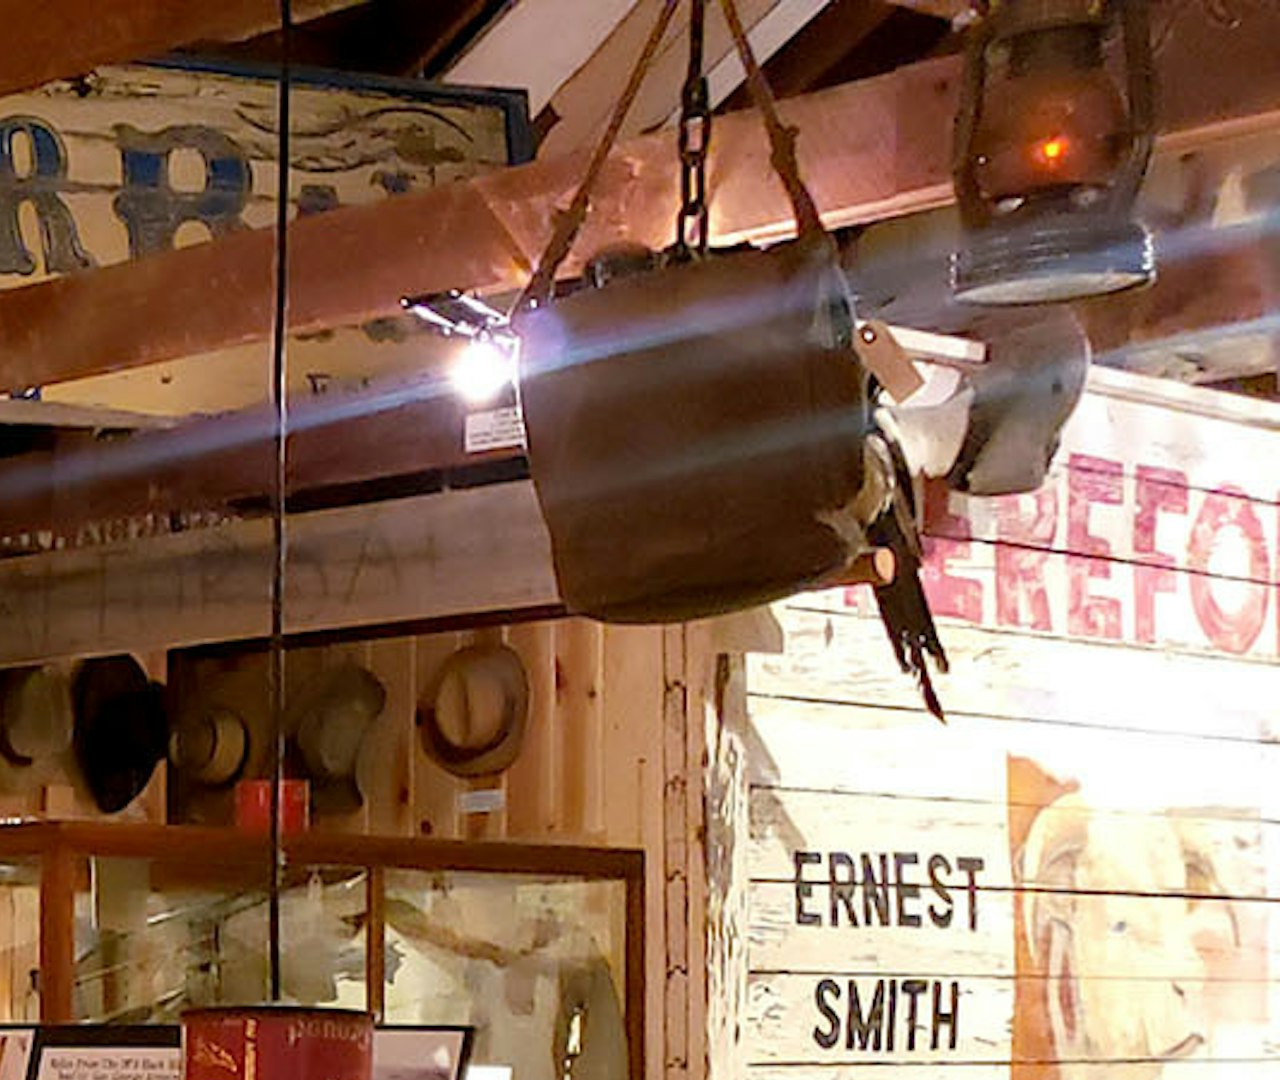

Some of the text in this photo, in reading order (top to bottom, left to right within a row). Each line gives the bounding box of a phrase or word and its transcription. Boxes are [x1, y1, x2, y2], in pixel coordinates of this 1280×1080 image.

[844, 452, 1280, 656] EREFO
[792, 850, 985, 932] ERNEST
[812, 977, 961, 1053] SMITH
